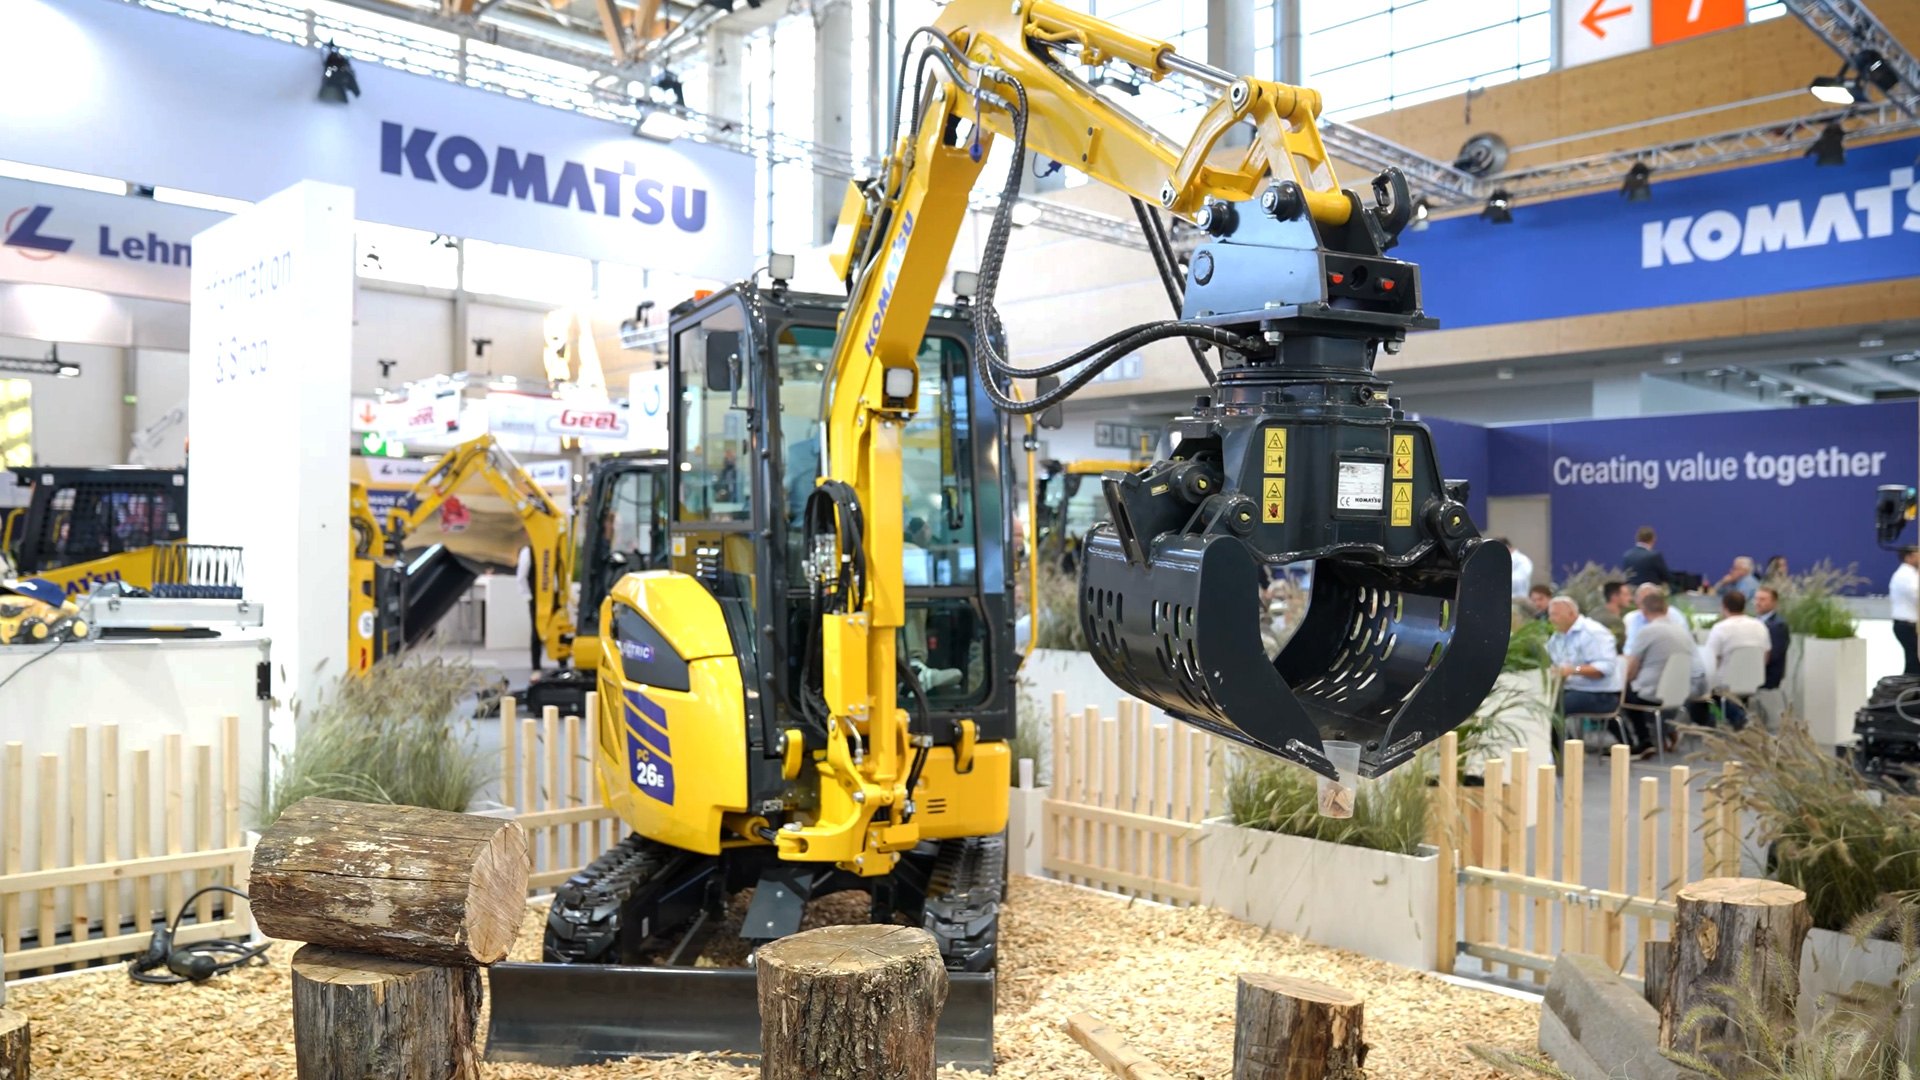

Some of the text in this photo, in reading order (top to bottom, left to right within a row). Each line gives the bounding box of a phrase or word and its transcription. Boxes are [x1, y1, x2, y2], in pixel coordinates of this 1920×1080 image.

[380, 120, 708, 234] KOMATSU
[864, 209, 914, 357] KOMATSU
[1553, 446, 1887, 489] Creating value together
[636, 748, 650, 761] PC
[636, 761, 665, 788] 26E
